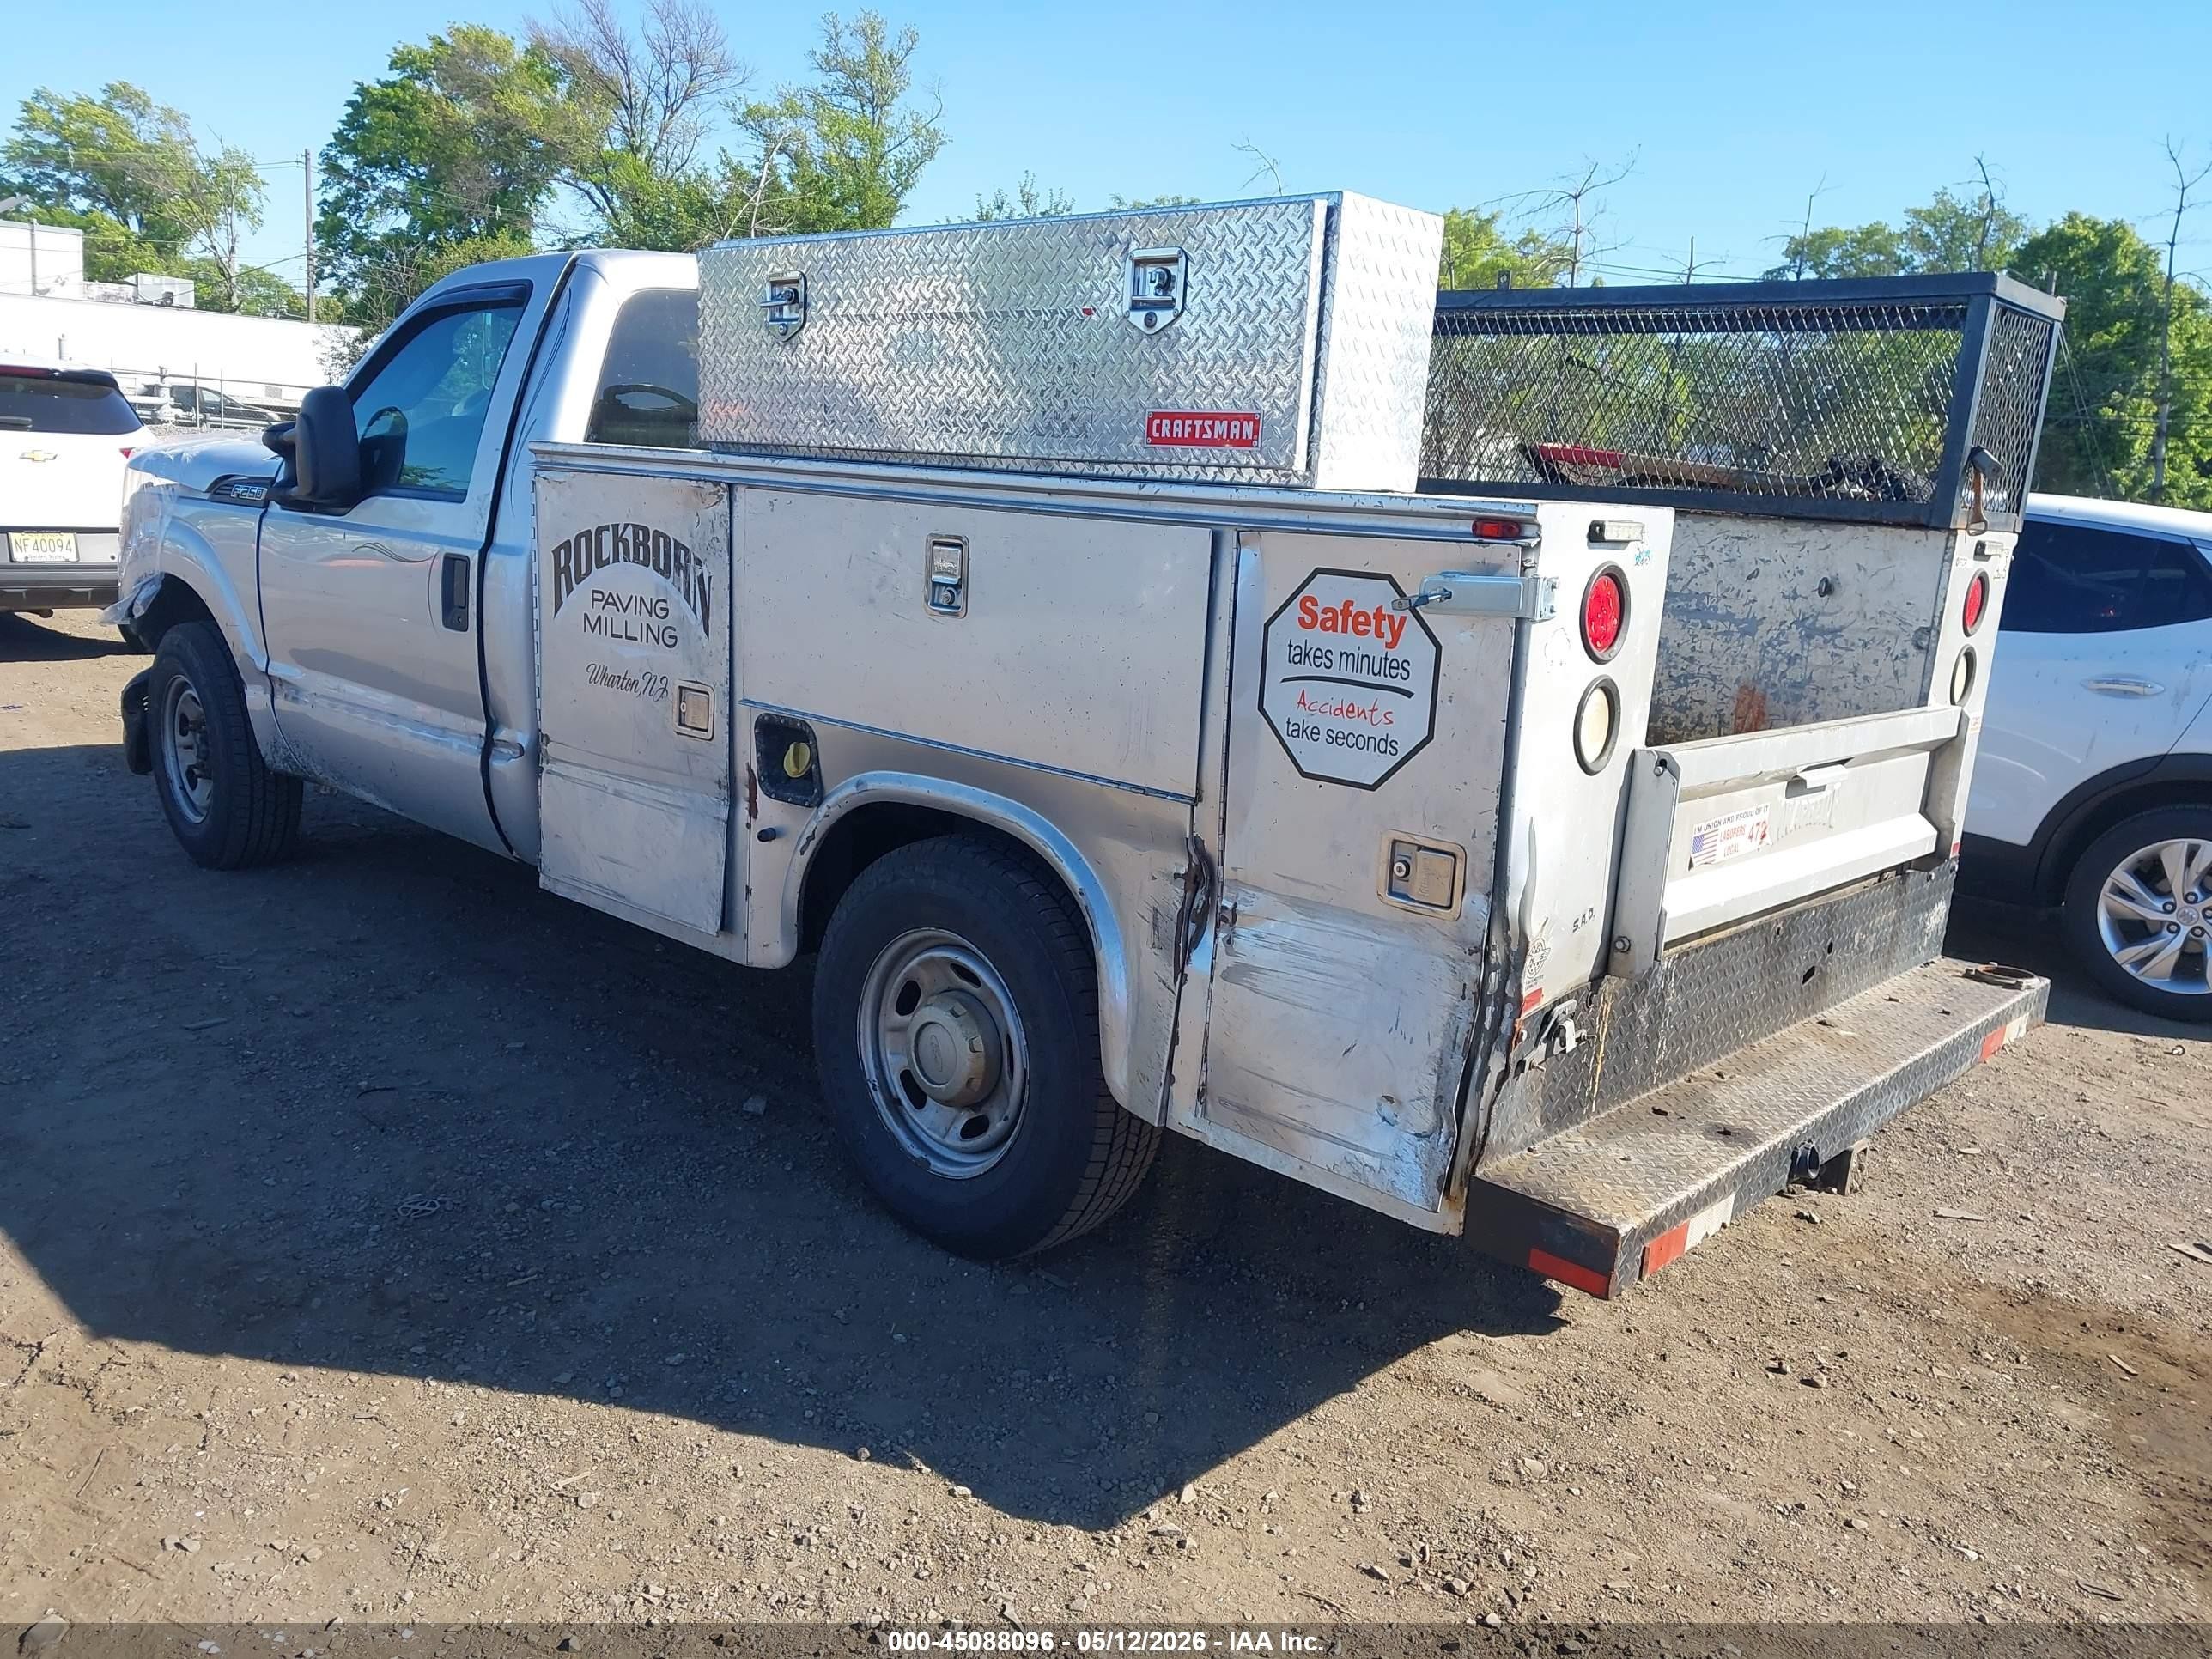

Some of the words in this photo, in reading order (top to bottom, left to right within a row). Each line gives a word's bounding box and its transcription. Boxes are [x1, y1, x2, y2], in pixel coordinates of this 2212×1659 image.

[1152, 419, 1254, 440] CRAFTSMAN
[552, 522, 713, 640] ROCKBORN
[591, 589, 670, 620] PAVING
[1297, 595, 1407, 649] Safety
[583, 612, 678, 648] MILLING
[1288, 638, 1334, 669] takes
[1338, 646, 1411, 681] minutes
[1297, 689, 1395, 726] Accidents
[1285, 717, 1321, 742] take
[1325, 732, 1399, 757] seconds
